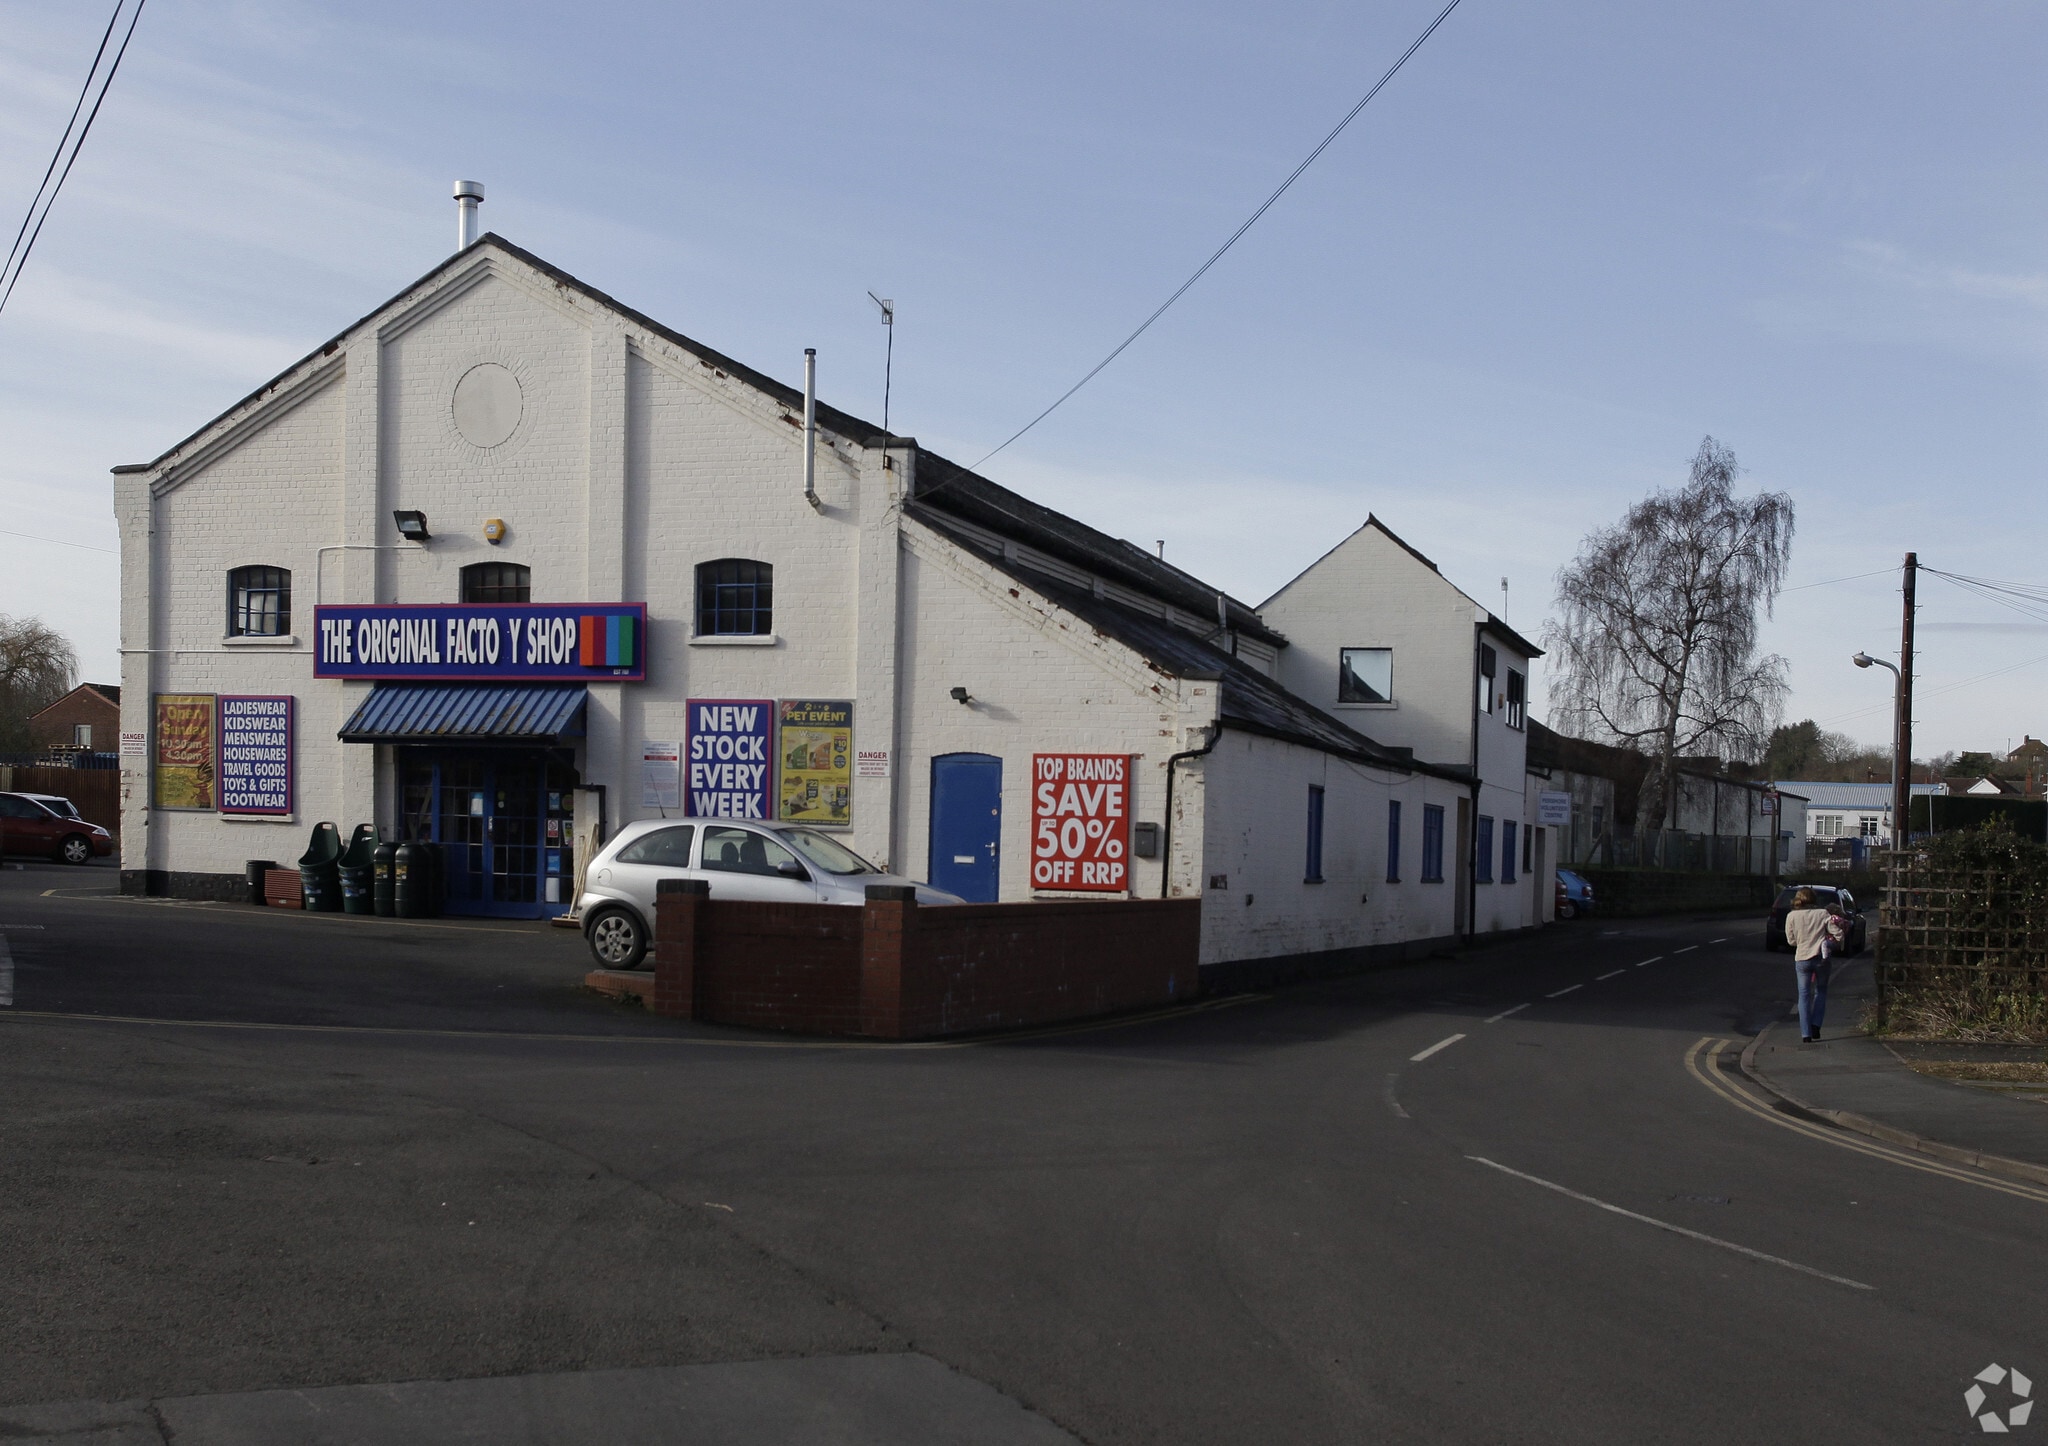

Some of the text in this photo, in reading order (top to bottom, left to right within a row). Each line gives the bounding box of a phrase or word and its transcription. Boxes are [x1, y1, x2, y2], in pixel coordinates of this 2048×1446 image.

[321, 619, 352, 664] THE
[357, 618, 440, 665] ORIGINAL
[526, 617, 576, 665] SHOP
[167, 706, 204, 722] Open
[223, 701, 287, 715] LADIESWEAR
[224, 717, 286, 730] KIDSWEAR
[700, 706, 758, 732] NEW
[786, 711, 847, 722] PET EVENT
[162, 722, 207, 738] Sunday
[224, 732, 286, 745] MENSWEAR
[223, 747, 287, 761] HOUSEWARES
[691, 734, 765, 760] STOCK
[858, 751, 887, 759] DANGER
[223, 762, 286, 776] TRAVEL GOODS
[691, 763, 766, 790] EVERY
[1036, 757, 1124, 781] TOP BRANDS
[223, 777, 287, 792] TOYS & GIFTS
[224, 793, 286, 807] FOOTWEAR
[693, 791, 763, 819] WEEK
[1036, 782, 1123, 817] SAVE
[1036, 817, 1123, 859] 50%
[1034, 860, 1124, 884] OFF RRP
